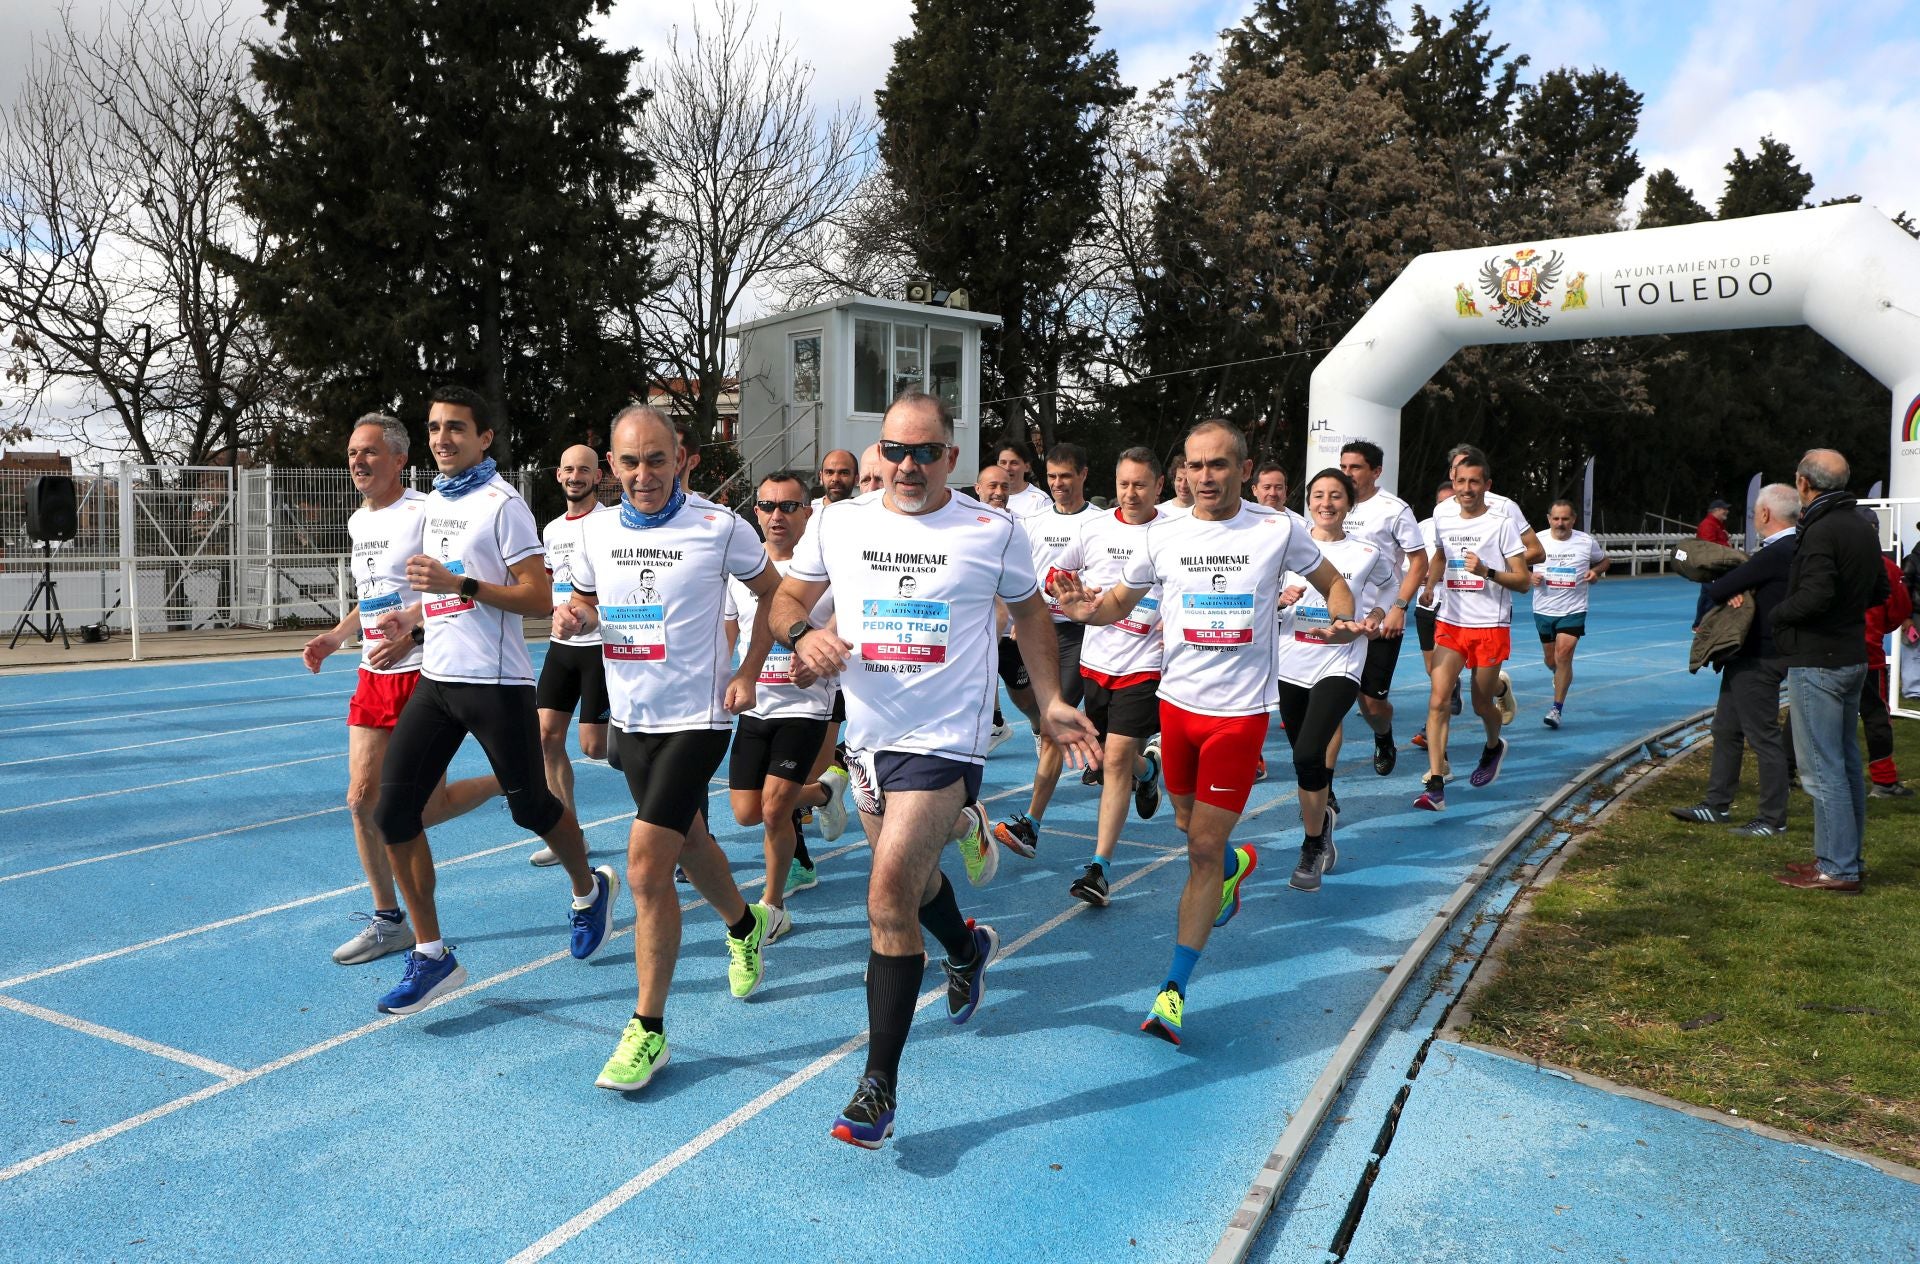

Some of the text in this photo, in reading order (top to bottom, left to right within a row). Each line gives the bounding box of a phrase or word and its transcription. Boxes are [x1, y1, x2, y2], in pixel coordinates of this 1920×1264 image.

[1614, 254, 1771, 279] AYUNTAMIENTO DE
[1614, 272, 1773, 307] TOLEDO
[612, 548, 684, 560] MILLA HOMENAJE
[862, 550, 948, 565] MILLA HOMENAJE
[1180, 555, 1250, 565] MILLA HOMENAJE
[430, 600, 461, 610] SOLISS
[862, 621, 948, 633] PEDRO TREJO
[622, 636, 634, 644] 14
[897, 633, 913, 643] 15
[877, 645, 931, 656] SOLISS
[864, 663, 922, 674] TOLEDO 8/2/025
